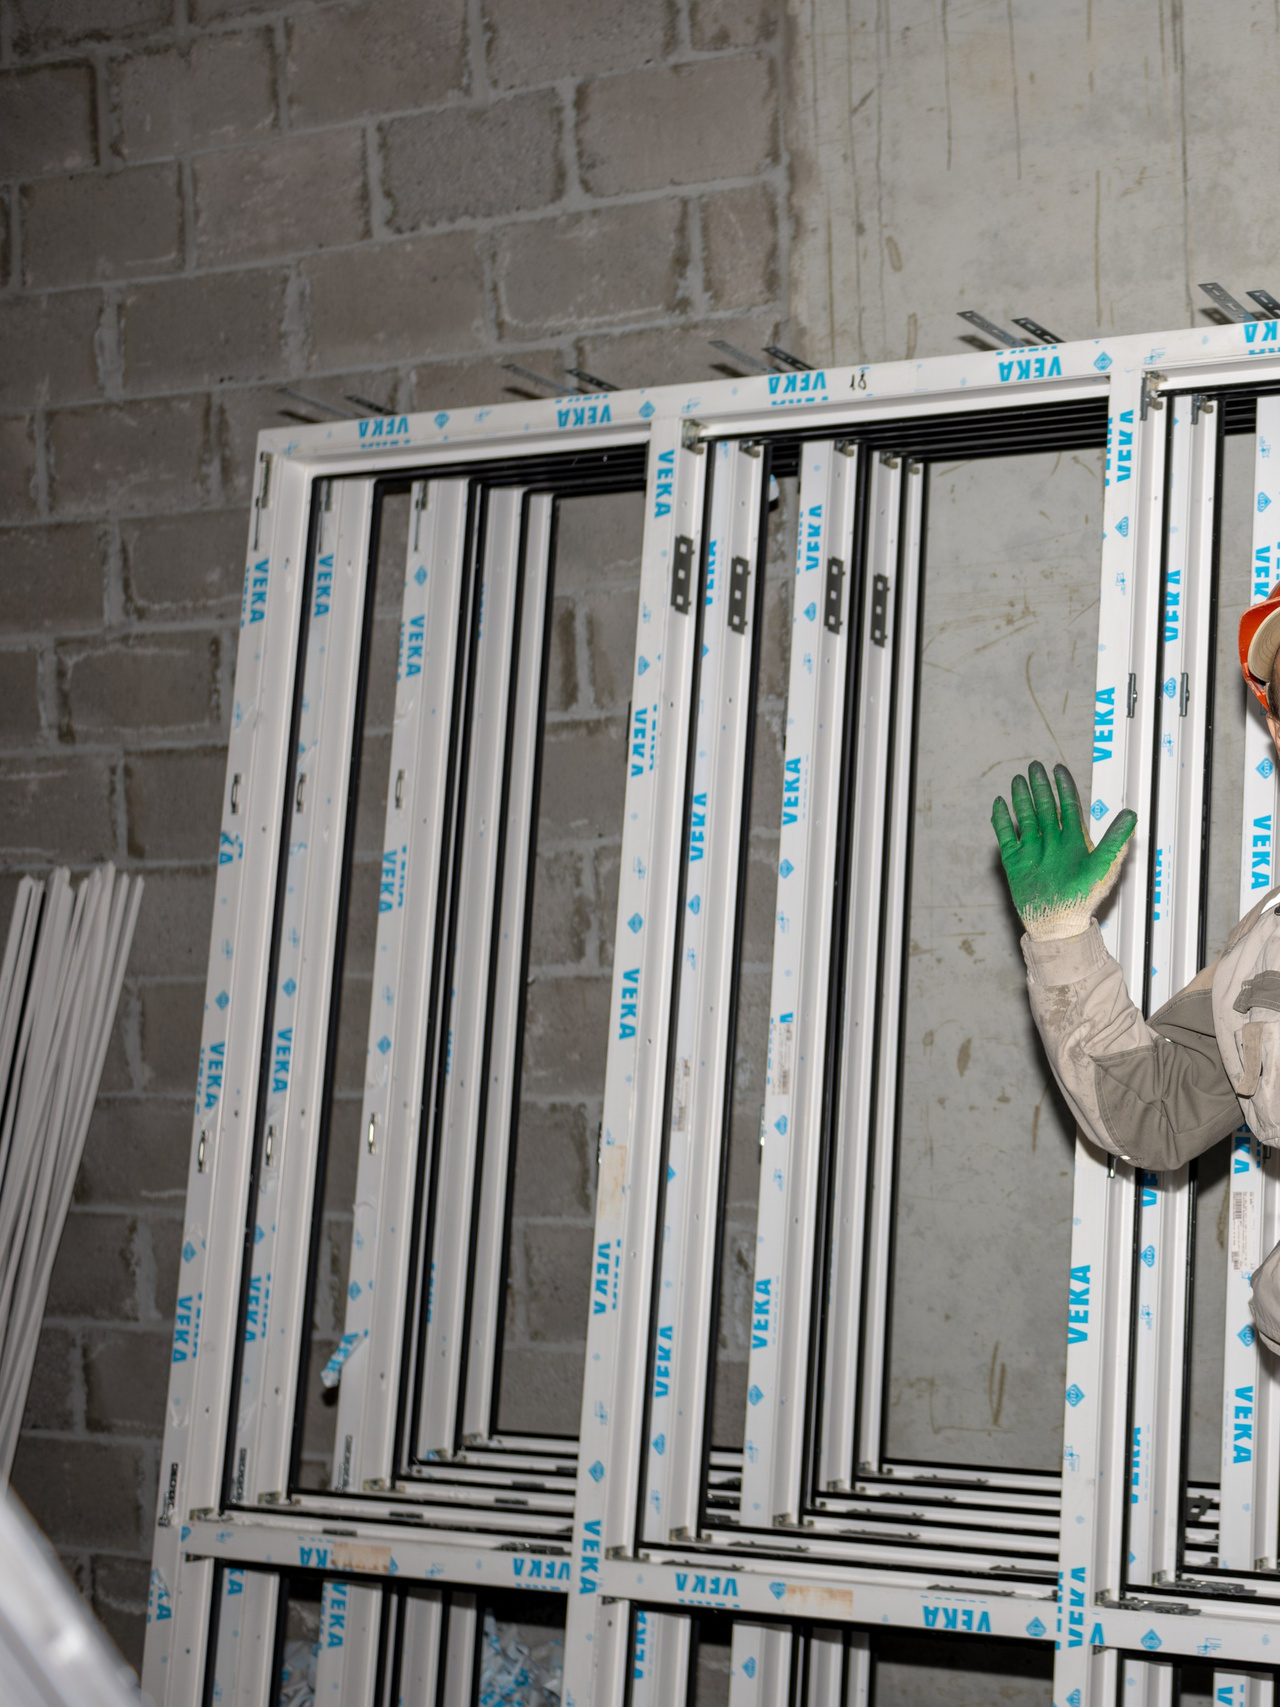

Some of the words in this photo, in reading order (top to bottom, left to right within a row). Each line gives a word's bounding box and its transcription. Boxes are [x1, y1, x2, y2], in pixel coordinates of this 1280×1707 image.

[769, 372, 826, 394] VEKA
[999, 356, 1061, 382] VEKA
[359, 417, 408, 437] VEKA
[558, 405, 611, 428] VEKA
[1117, 410, 1134, 482] VEKA
[655, 450, 675, 517] VEKA
[806, 505, 822, 571] VEKA
[249, 559, 269, 623] VEKA
[314, 555, 333, 617] VEKA
[1254, 546, 1270, 597] VEK
[1163, 570, 1181, 642] VEKA
[404, 615, 425, 676] VEKA
[631, 709, 647, 777] VEKA
[1093, 687, 1115, 763] VEKA
[782, 758, 801, 825] VEKA
[219, 833, 234, 865] KA
[688, 793, 707, 862] VEKA
[1251, 815, 1271, 889] VEKA
[379, 851, 397, 912] VEKA
[619, 968, 640, 1040] VEKA
[203, 1043, 225, 1108] VEKA
[272, 1028, 292, 1093] VEKA
[1140, 1172, 1158, 1208] VE
[244, 1277, 261, 1342] VEKA
[594, 1243, 611, 1314] VEKA
[1067, 1265, 1090, 1344] VEKA
[172, 1296, 194, 1363] VEKA
[752, 1279, 771, 1349] VEKA
[326, 1332, 358, 1375] VEK
[653, 1326, 673, 1398] VEKA
[1233, 1386, 1253, 1464] VEKA
[227, 1568, 244, 1595] KA
[300, 1547, 328, 1568] KA
[513, 1558, 570, 1580] VEKA
[579, 1520, 601, 1594] VEKA
[676, 1573, 738, 1596] VEKA
[326, 1582, 347, 1648] VEKA
[923, 1606, 991, 1632] VEKA
[1068, 1567, 1086, 1647] VEKA
